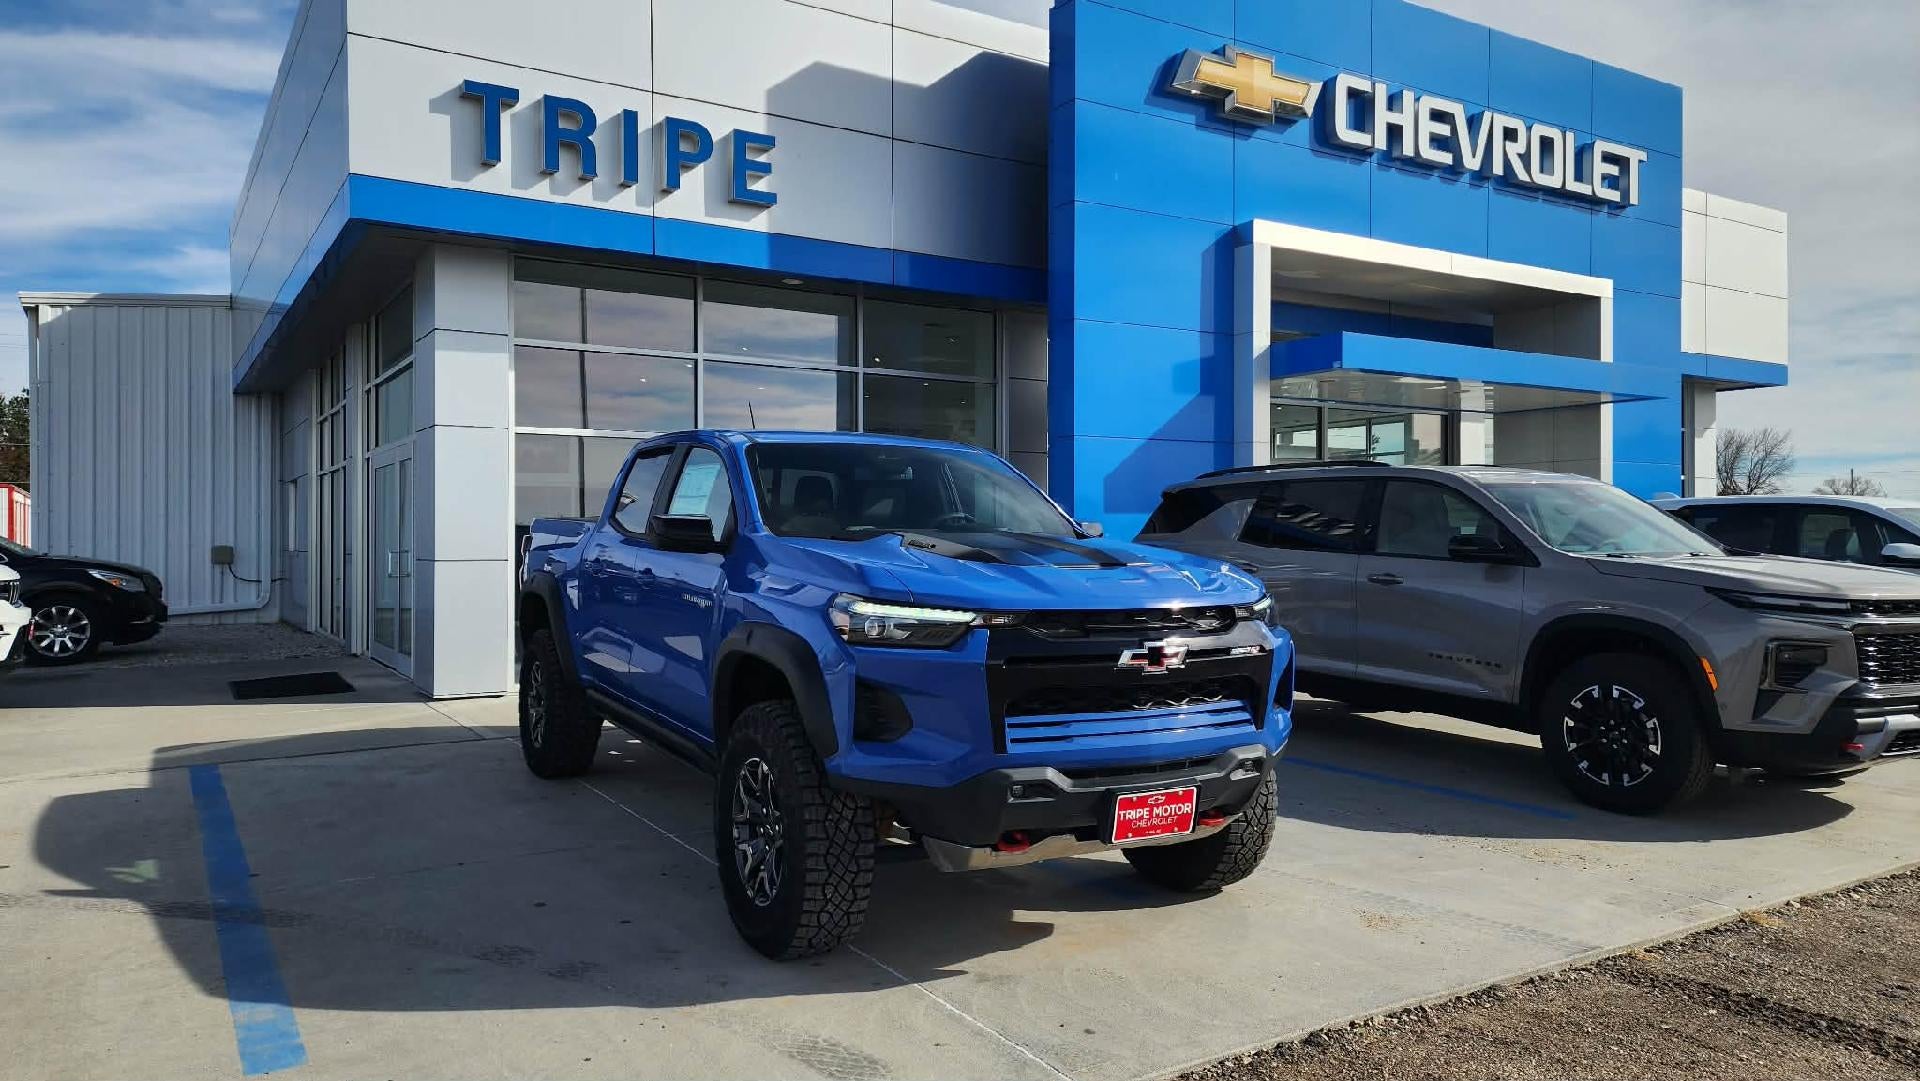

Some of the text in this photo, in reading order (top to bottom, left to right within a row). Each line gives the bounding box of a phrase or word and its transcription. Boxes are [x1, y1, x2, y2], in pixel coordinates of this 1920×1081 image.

[461, 79, 777, 207] TRIPE
[1335, 73, 1647, 205] CHEVROLET
[1119, 803, 1192, 820] TRIPE MOTOR
[1132, 816, 1177, 828] CHEVROLET
